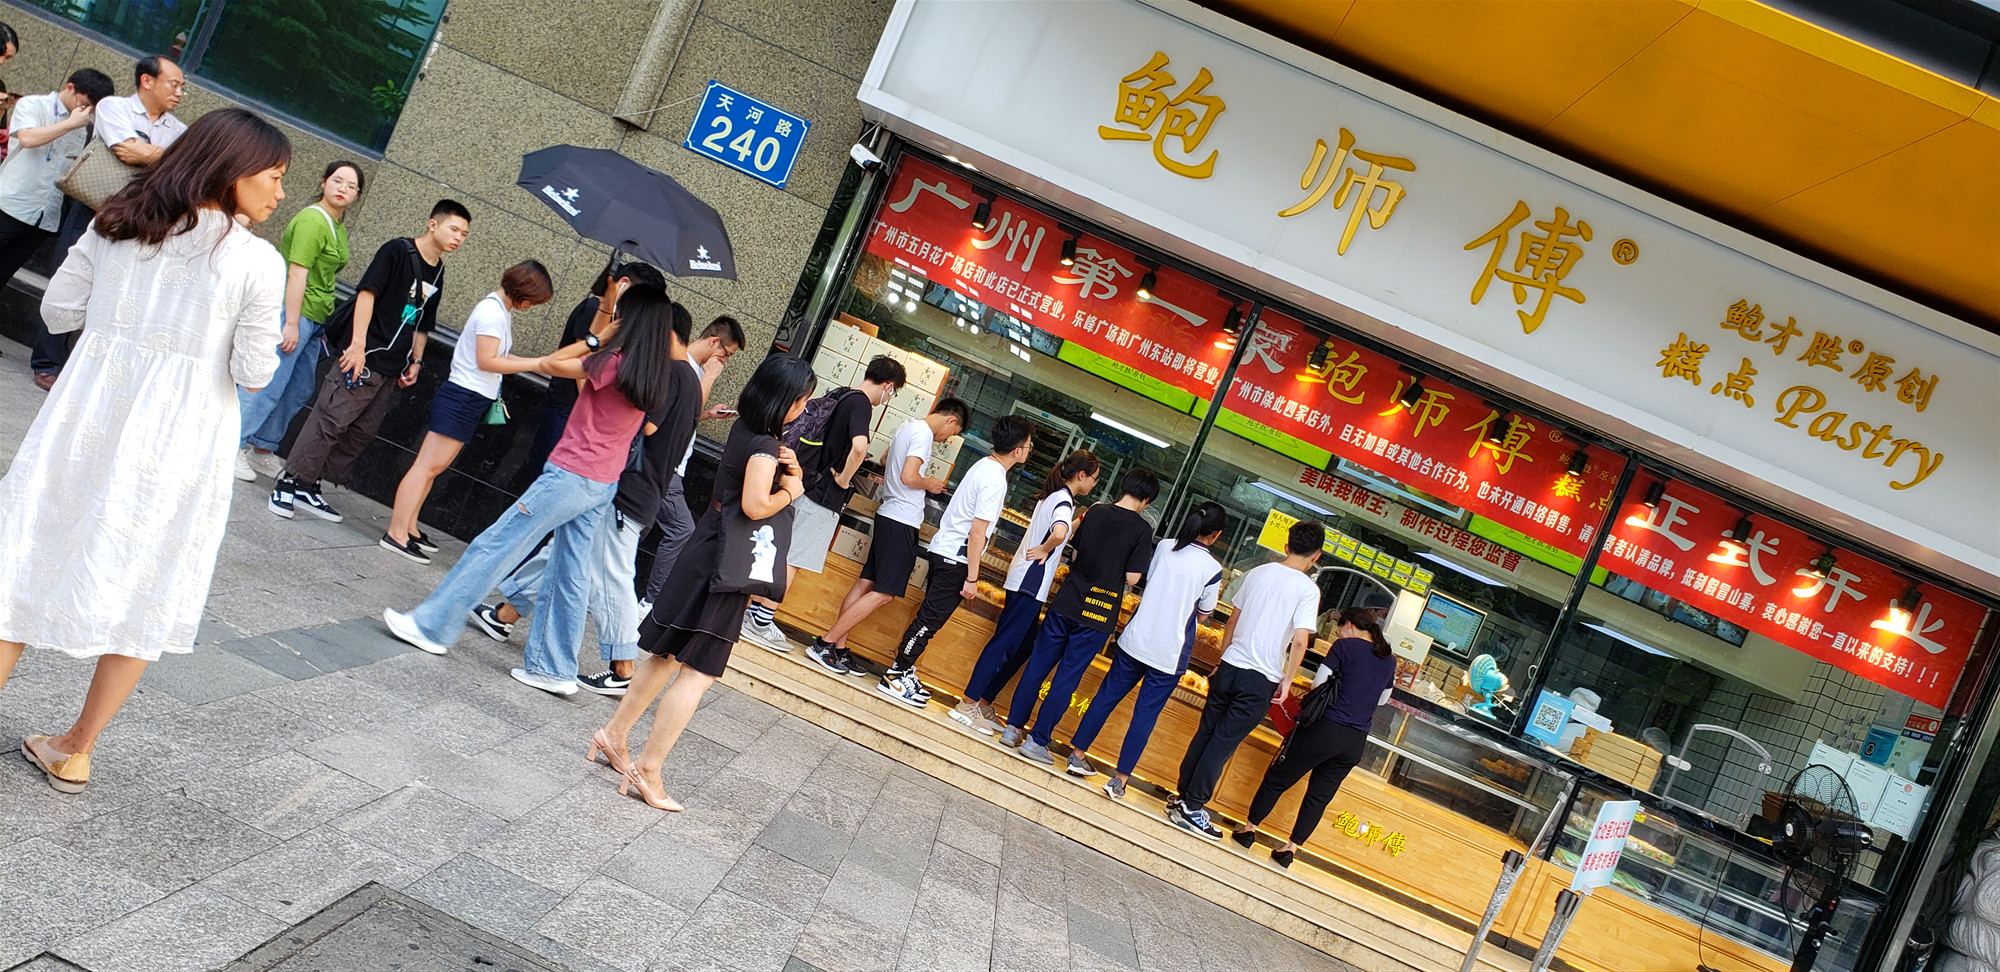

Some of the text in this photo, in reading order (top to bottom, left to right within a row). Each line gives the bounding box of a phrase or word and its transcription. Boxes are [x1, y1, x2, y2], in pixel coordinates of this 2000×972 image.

[702, 115, 781, 172] 240
[716, 93, 793, 138] 天河路
[1098, 51, 1587, 335] 鲍师傅
[1656, 332, 1944, 490] 糕点 Pastry
[1624, 493, 1949, 655] 正式开业
[1082, 610, 1108, 623] HARMONY
[1333, 811, 1408, 857] 鲍师傅
